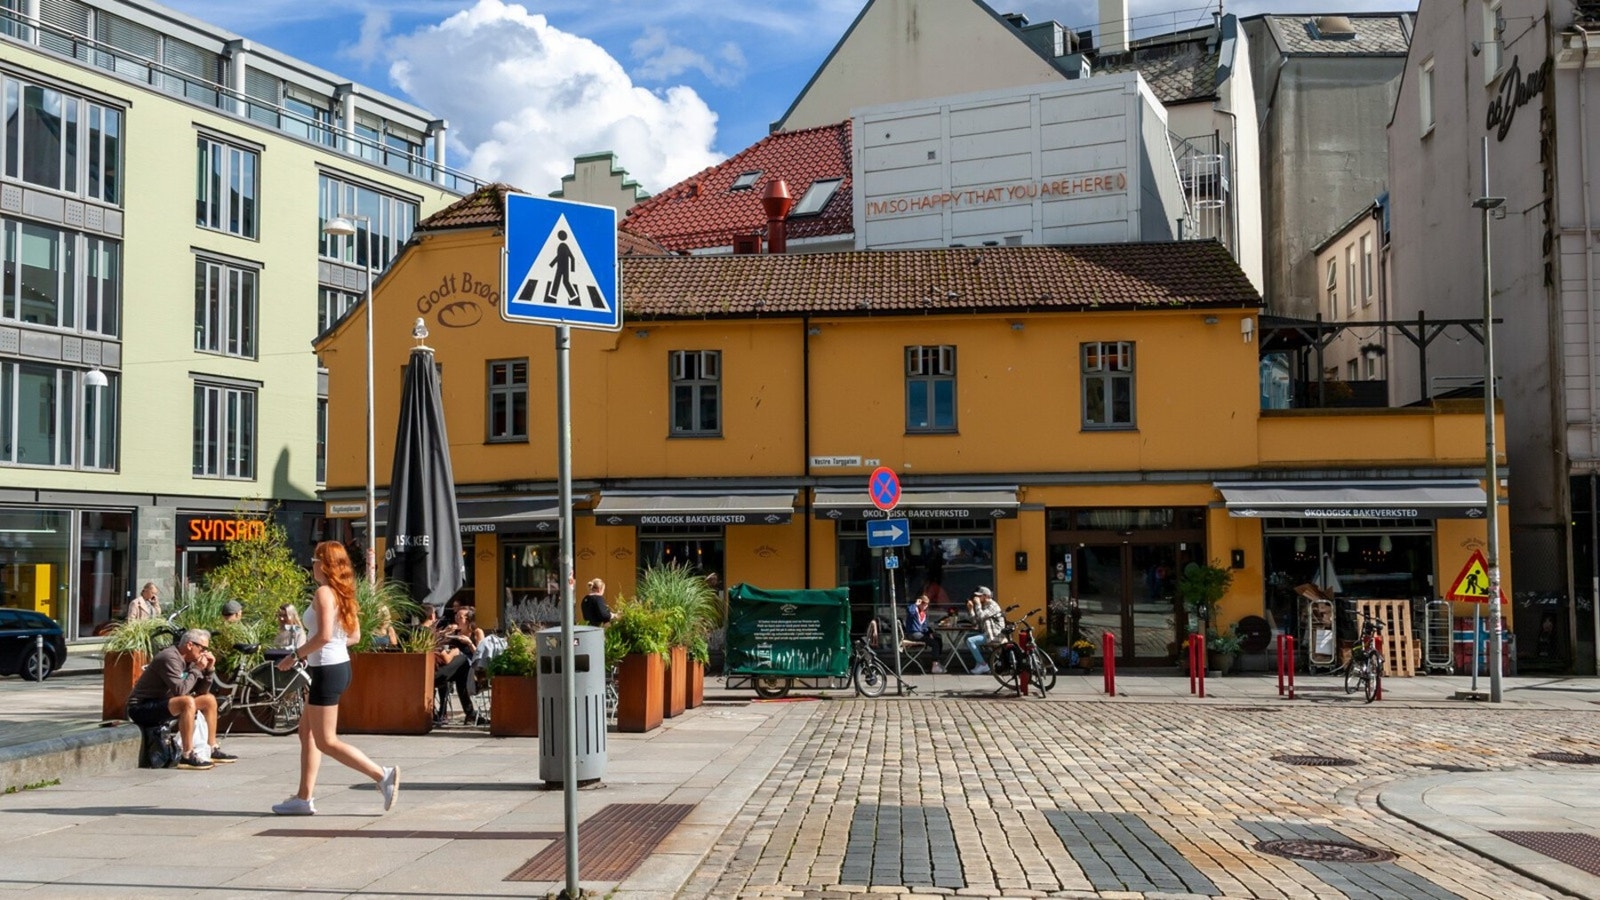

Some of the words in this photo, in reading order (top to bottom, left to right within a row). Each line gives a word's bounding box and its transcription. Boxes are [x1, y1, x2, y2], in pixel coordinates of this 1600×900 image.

[866, 200, 888, 216] I'M
[889, 198, 908, 214] SO
[910, 191, 962, 212] HAPPY
[967, 187, 1004, 205] THAT
[1006, 183, 1038, 201] YOU
[1040, 180, 1070, 197] ARE
[1072, 175, 1113, 194] HERE
[416, 273, 458, 314] Godt
[641, 515, 684, 524] ØKOLOGISK
[686, 515, 746, 524] BAKEVERKSTED
[862, 509, 907, 518] ØKOLGISK
[908, 509, 970, 518] BAKEVERKSTED
[1304, 509, 1352, 517] ØKOLOGISK
[1353, 509, 1418, 517] BAKEVERKSTED
[189, 519, 266, 541] SYNSAM
